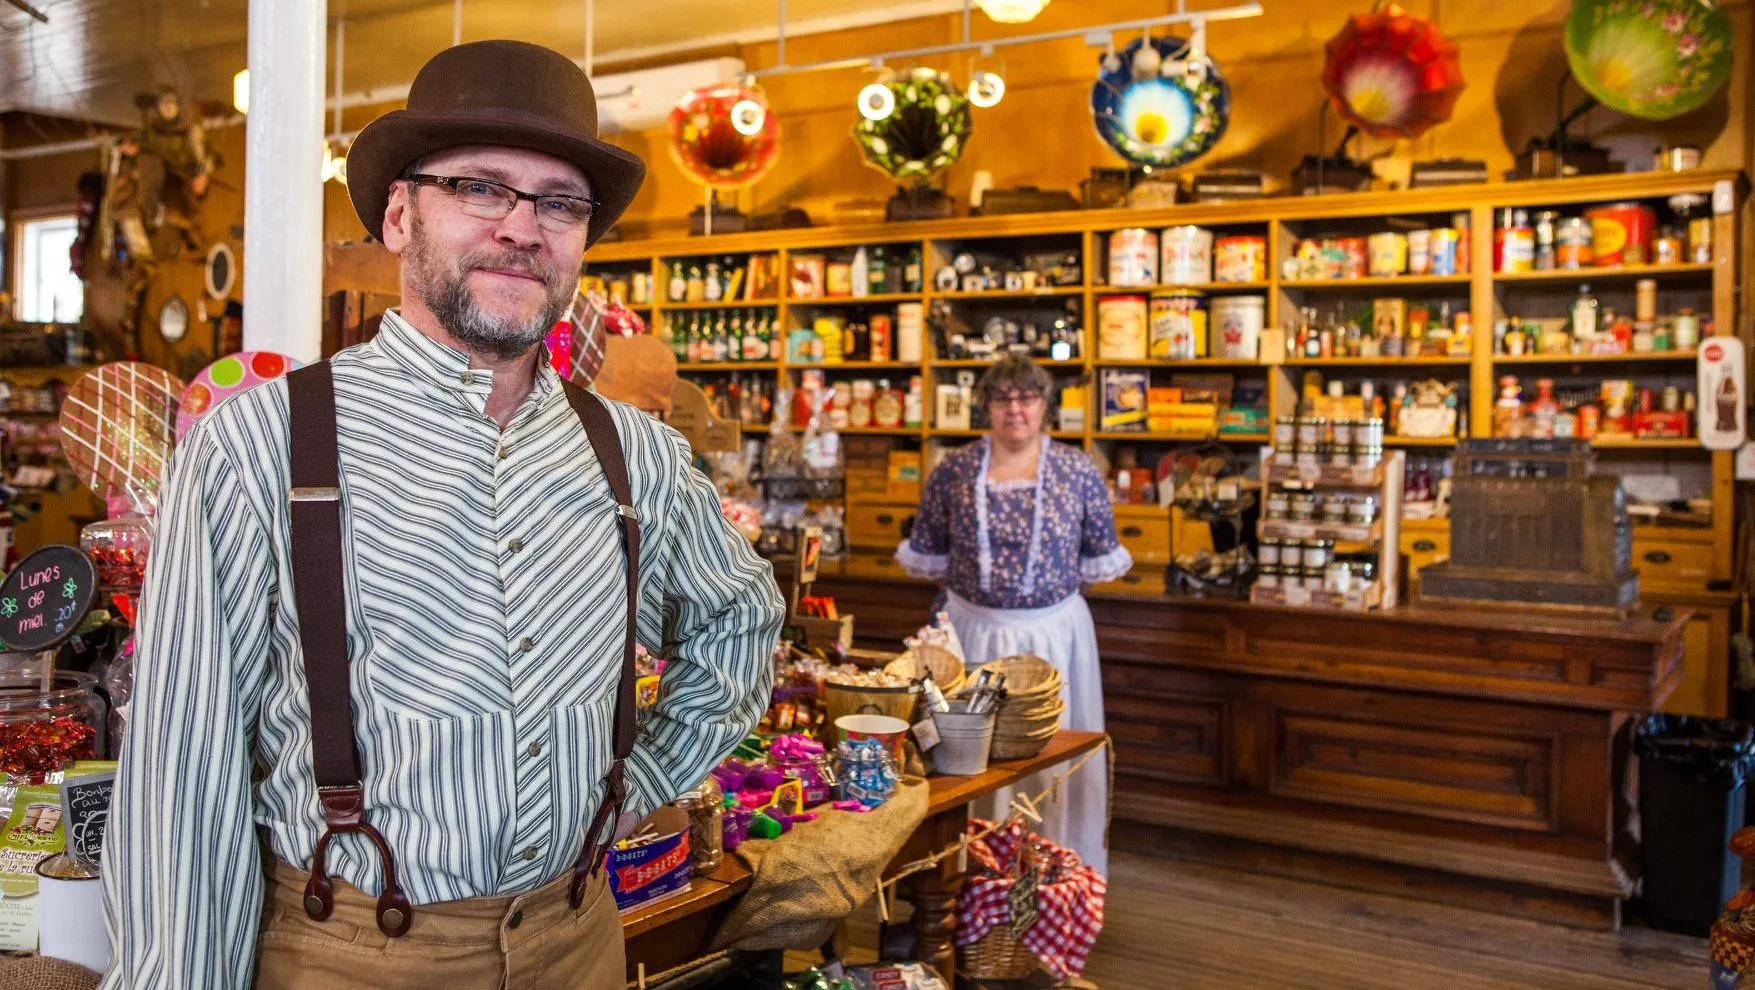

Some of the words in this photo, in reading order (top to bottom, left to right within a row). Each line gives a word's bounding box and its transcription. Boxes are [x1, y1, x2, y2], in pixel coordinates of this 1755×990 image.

[20, 565, 60, 590] Lunes
[28, 590, 45, 608] de
[71, 784, 113, 808] Bonbo
[20, 865, 36, 874] ru
